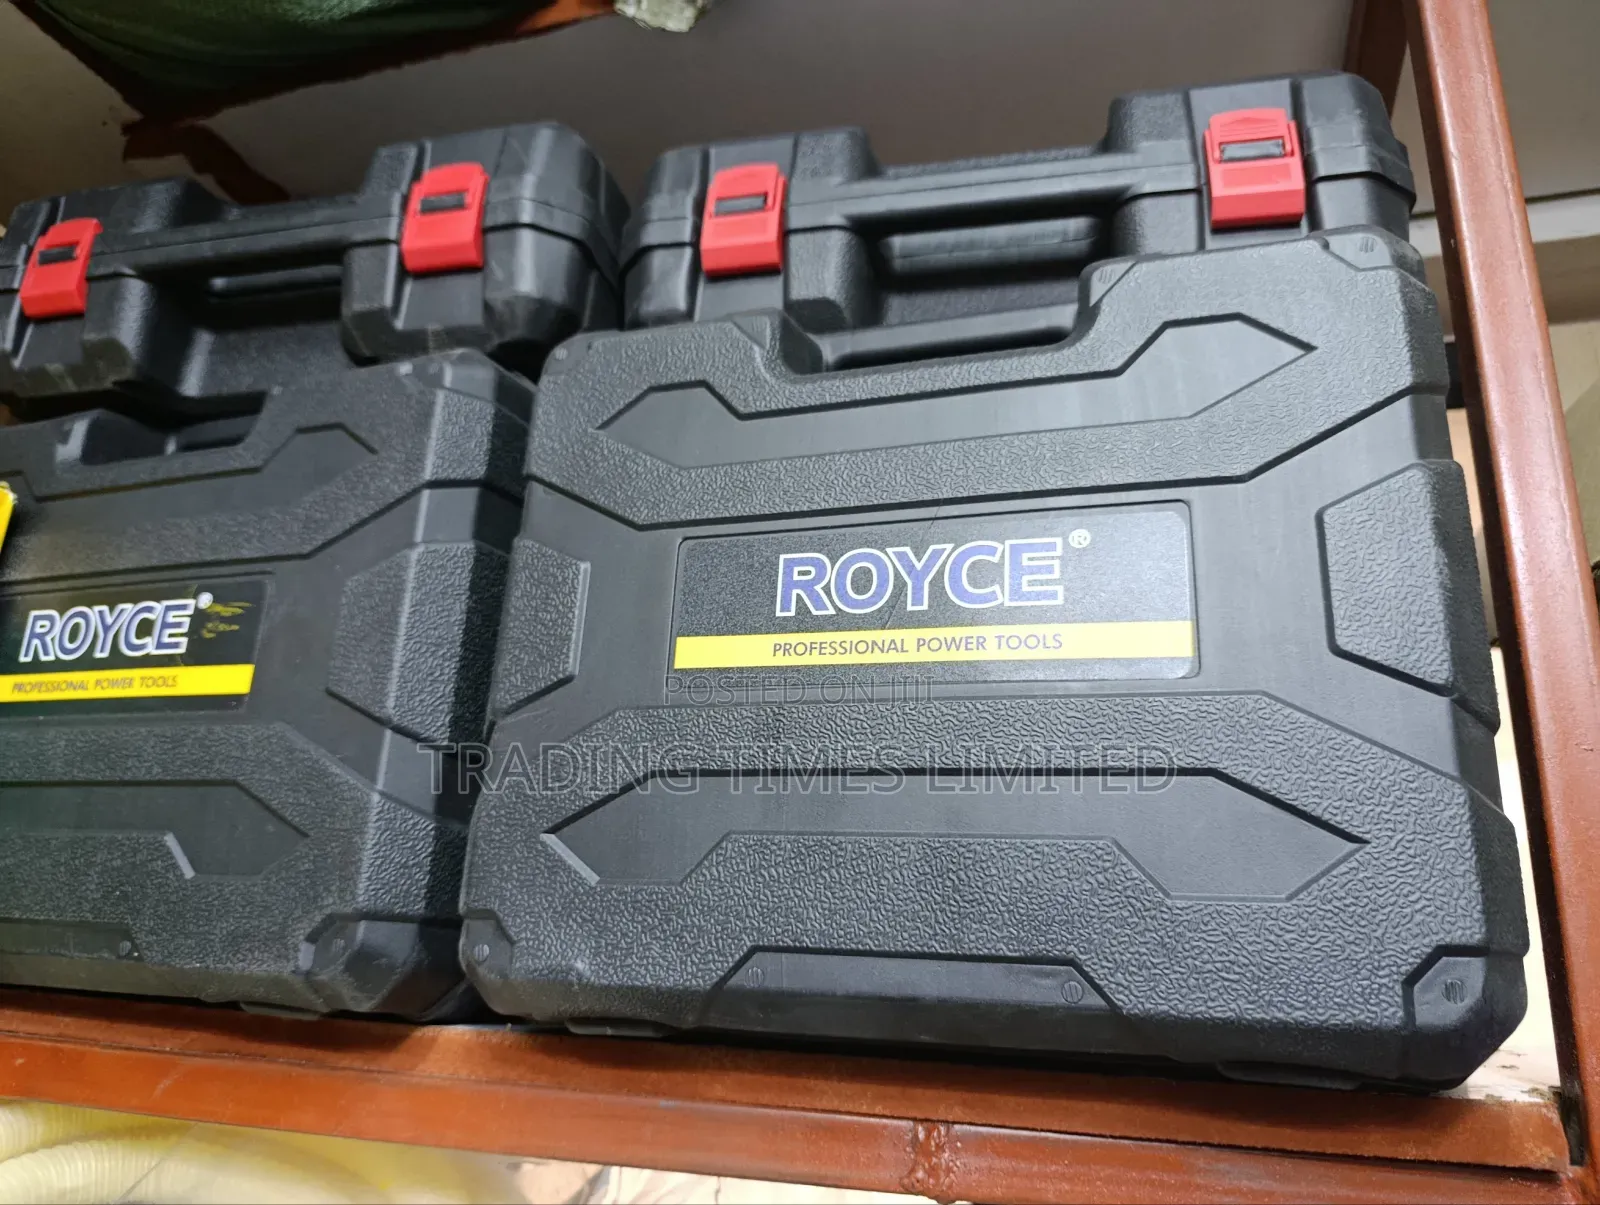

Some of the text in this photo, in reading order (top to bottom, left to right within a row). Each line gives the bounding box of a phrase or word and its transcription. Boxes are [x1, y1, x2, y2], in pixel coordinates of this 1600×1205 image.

[772, 633, 1063, 658] PROFESSIONAL POWER TOOLS
[11, 674, 177, 694] PROFESSIONAL POWER TOOLS
